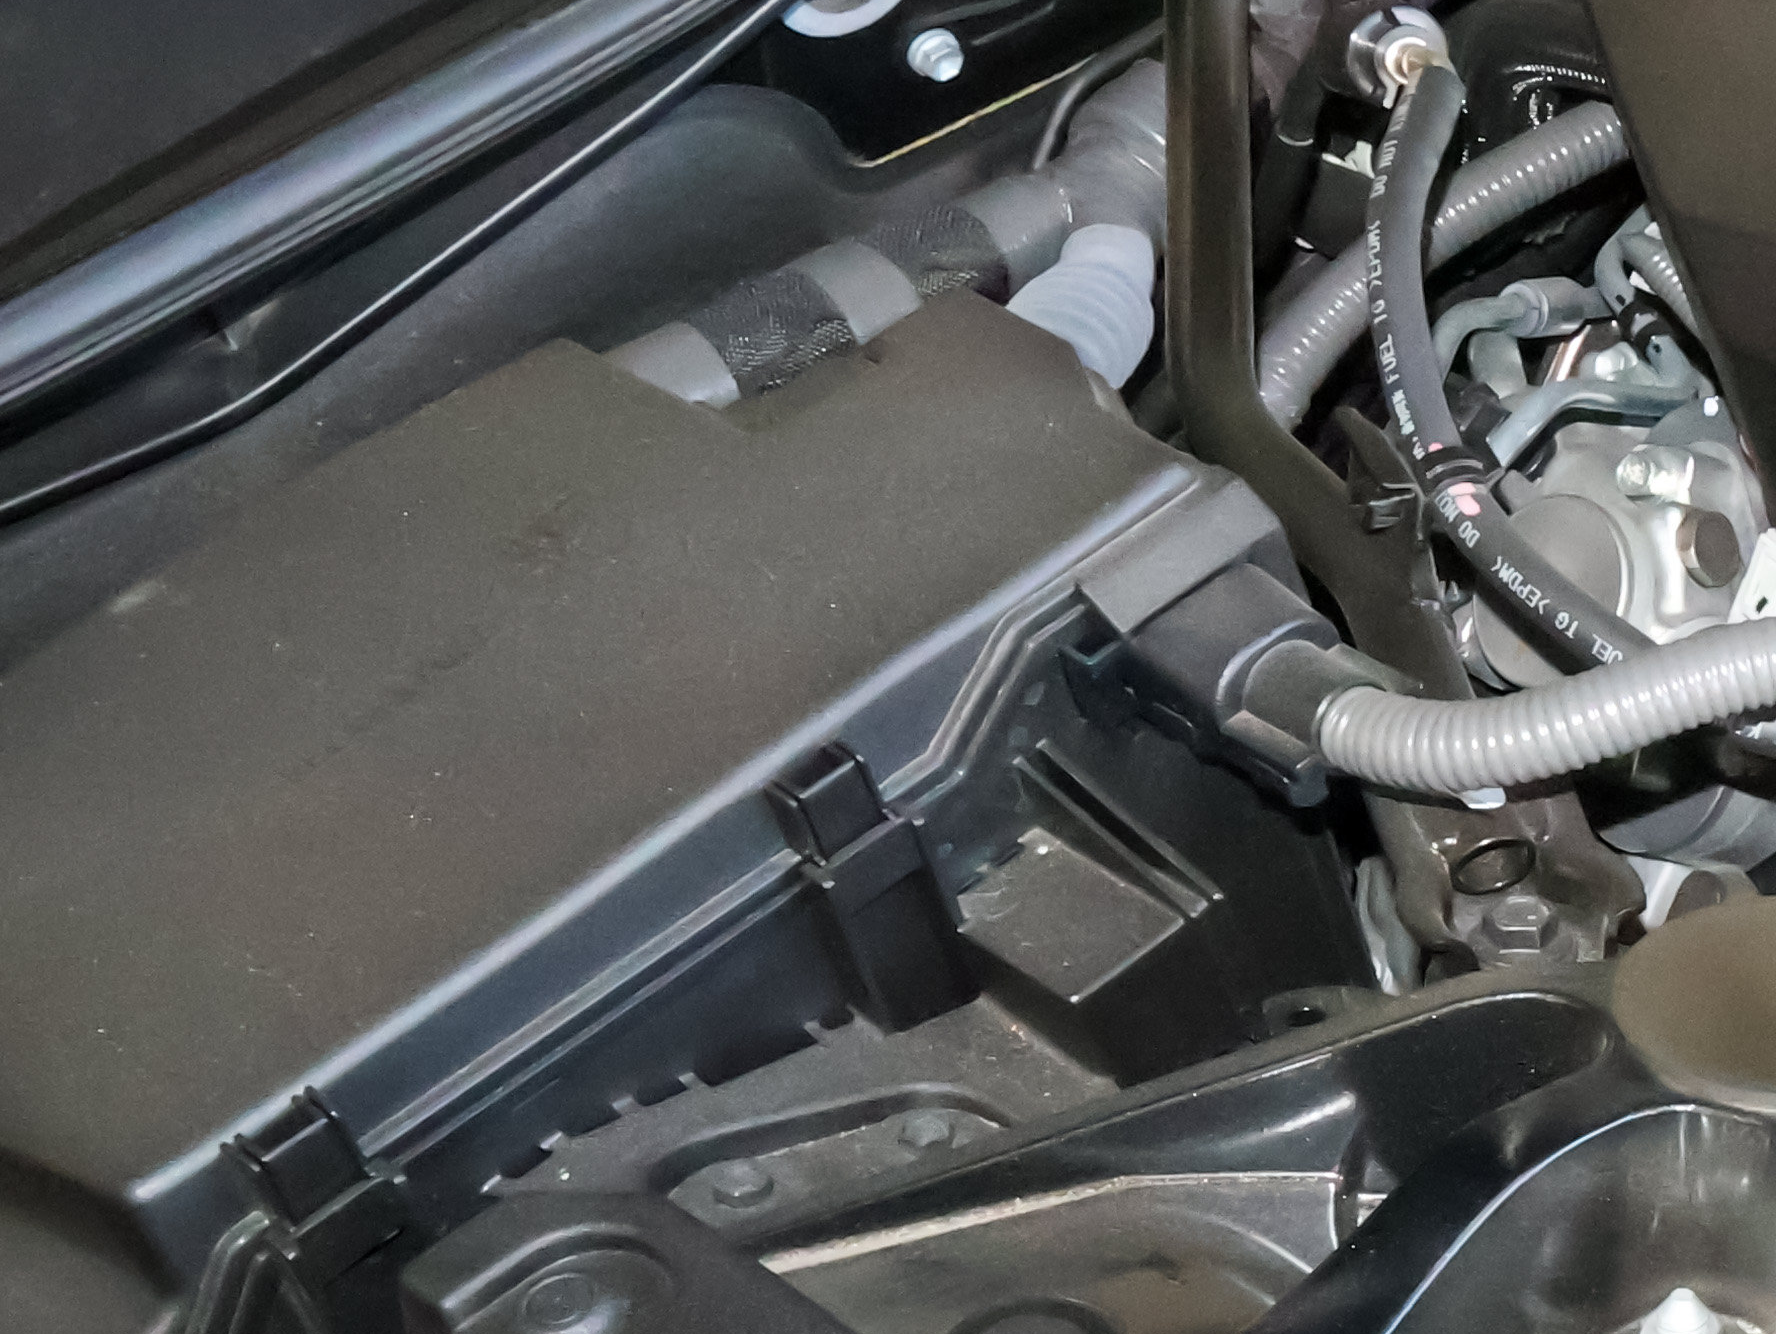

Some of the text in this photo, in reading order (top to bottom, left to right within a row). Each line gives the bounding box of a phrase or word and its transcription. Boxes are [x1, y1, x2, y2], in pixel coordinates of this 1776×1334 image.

[1379, 333, 1400, 385] FUEL
[1457, 521, 1481, 548] DO
[1490, 555, 1550, 615] >EPDM<
[1554, 611, 1578, 639] TG
